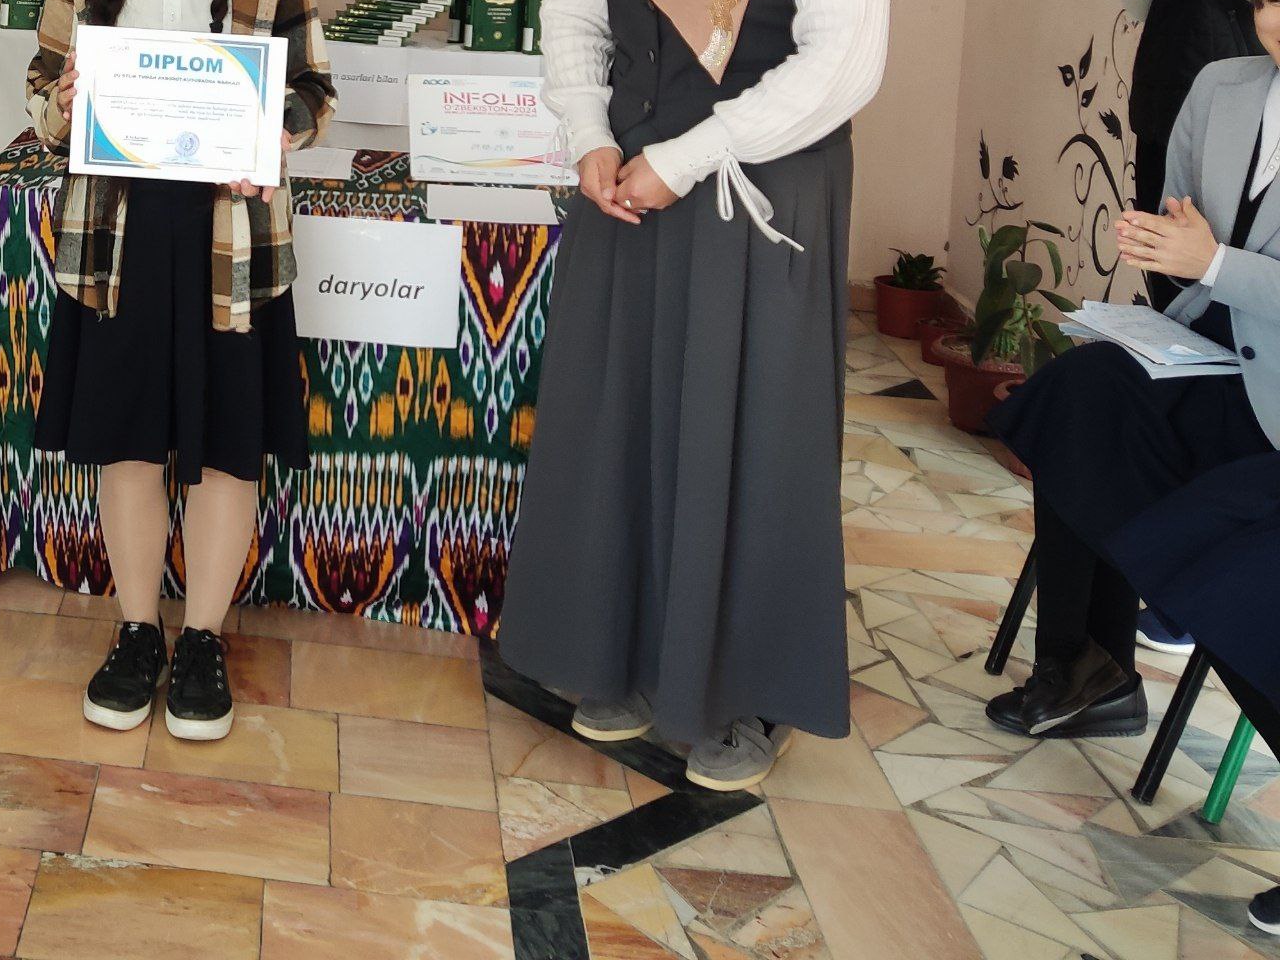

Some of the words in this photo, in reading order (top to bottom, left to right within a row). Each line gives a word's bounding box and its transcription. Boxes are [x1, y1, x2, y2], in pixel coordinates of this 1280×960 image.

[138, 52, 224, 74] DIPLOM
[443, 91, 537, 107] INFOLIB
[318, 273, 425, 301] daryolar
